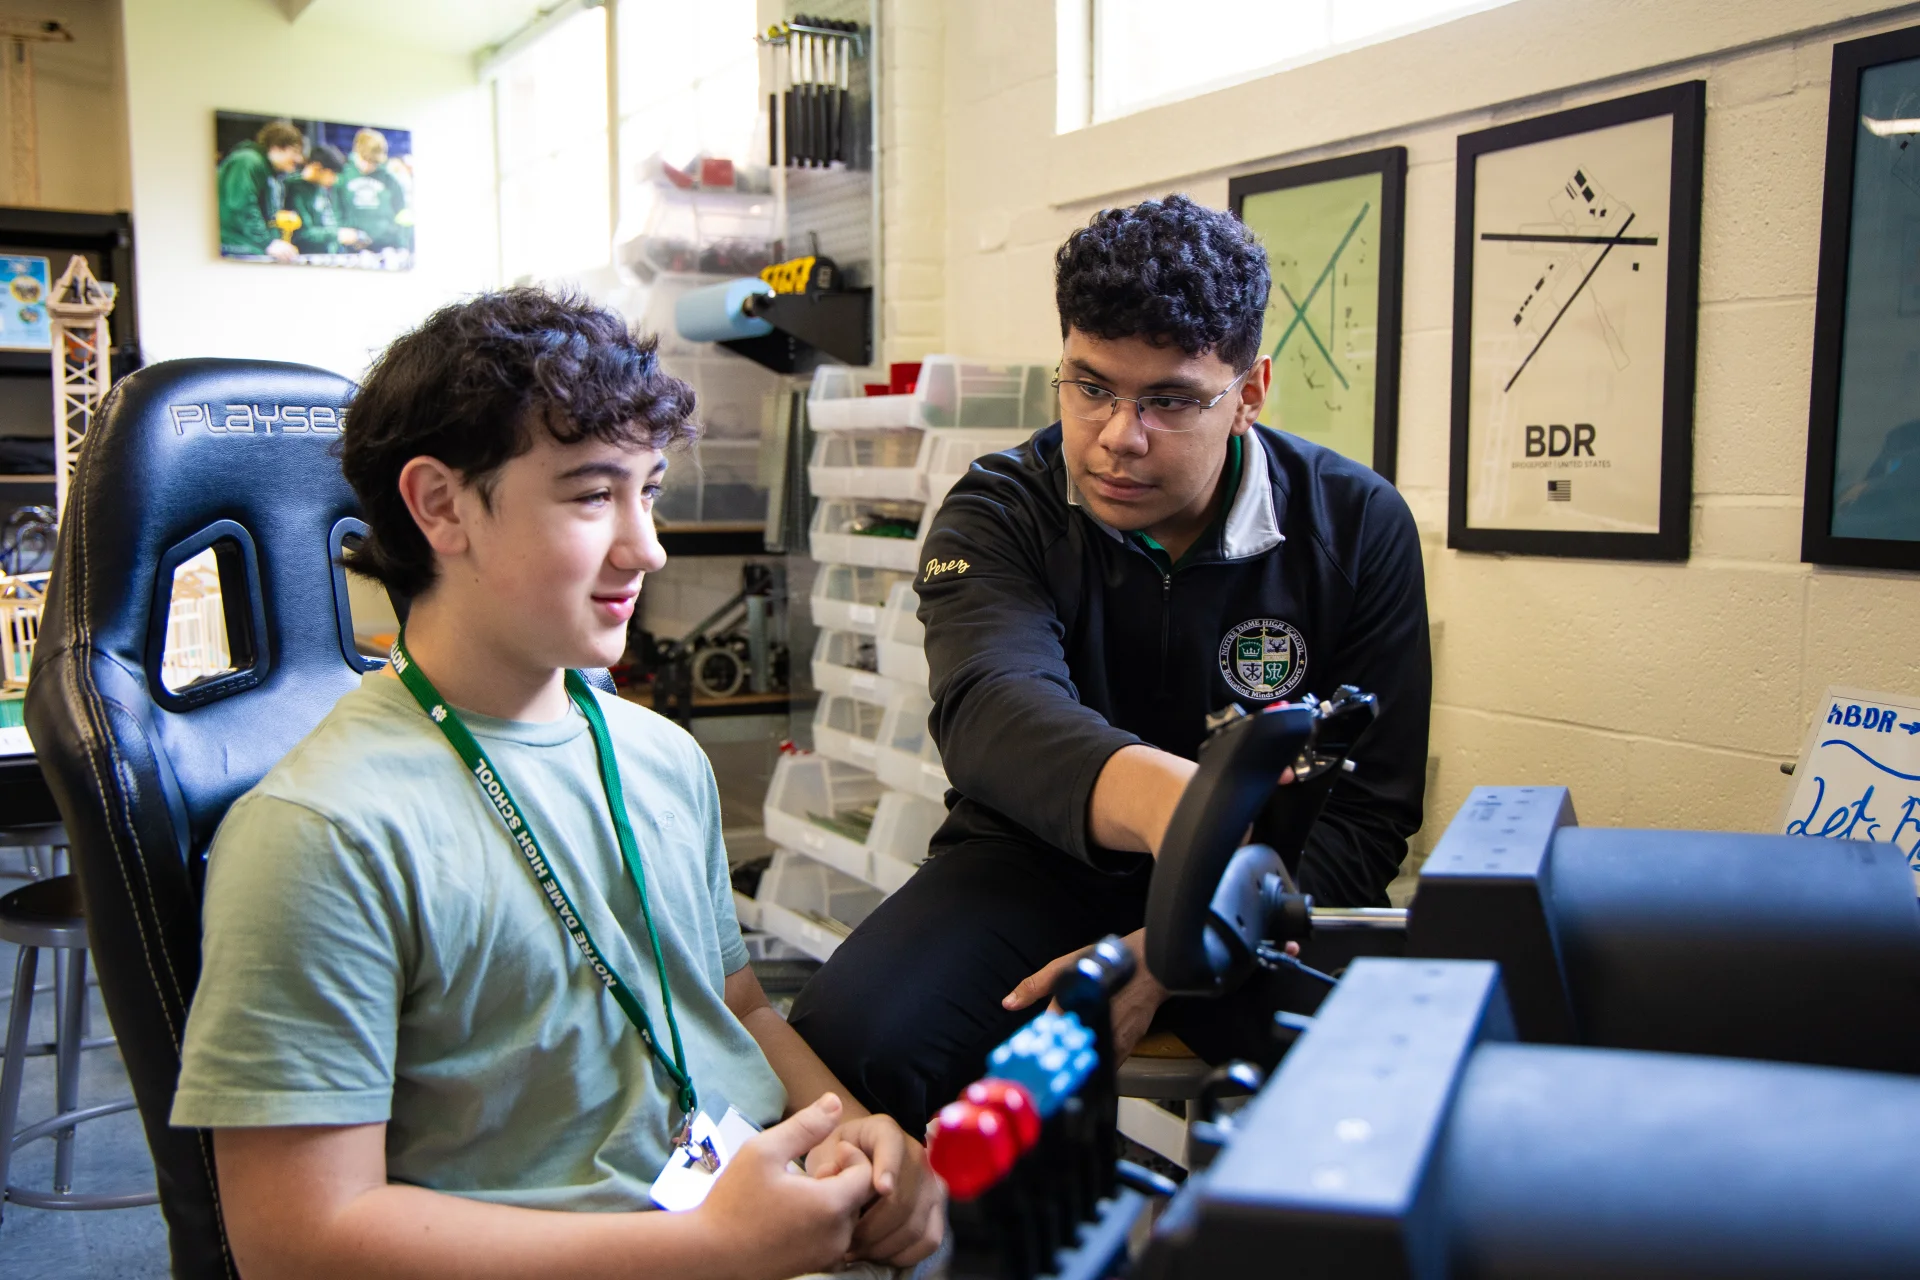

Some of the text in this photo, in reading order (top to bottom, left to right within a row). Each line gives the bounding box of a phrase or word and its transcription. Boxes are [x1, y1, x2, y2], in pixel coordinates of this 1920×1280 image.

[1525, 423, 1596, 457] BDR
[1558, 461, 1583, 469] UNITED
[1584, 460, 1611, 469] STATES
[923, 558, 971, 583] Perez
[1221, 619, 1304, 656] NOTRE DAME HIGH SCHOOL
[1223, 668, 1303, 698] Educating Minds and Hearts
[475, 757, 617, 988] NOTRE DAME HIGH SCHOOL
